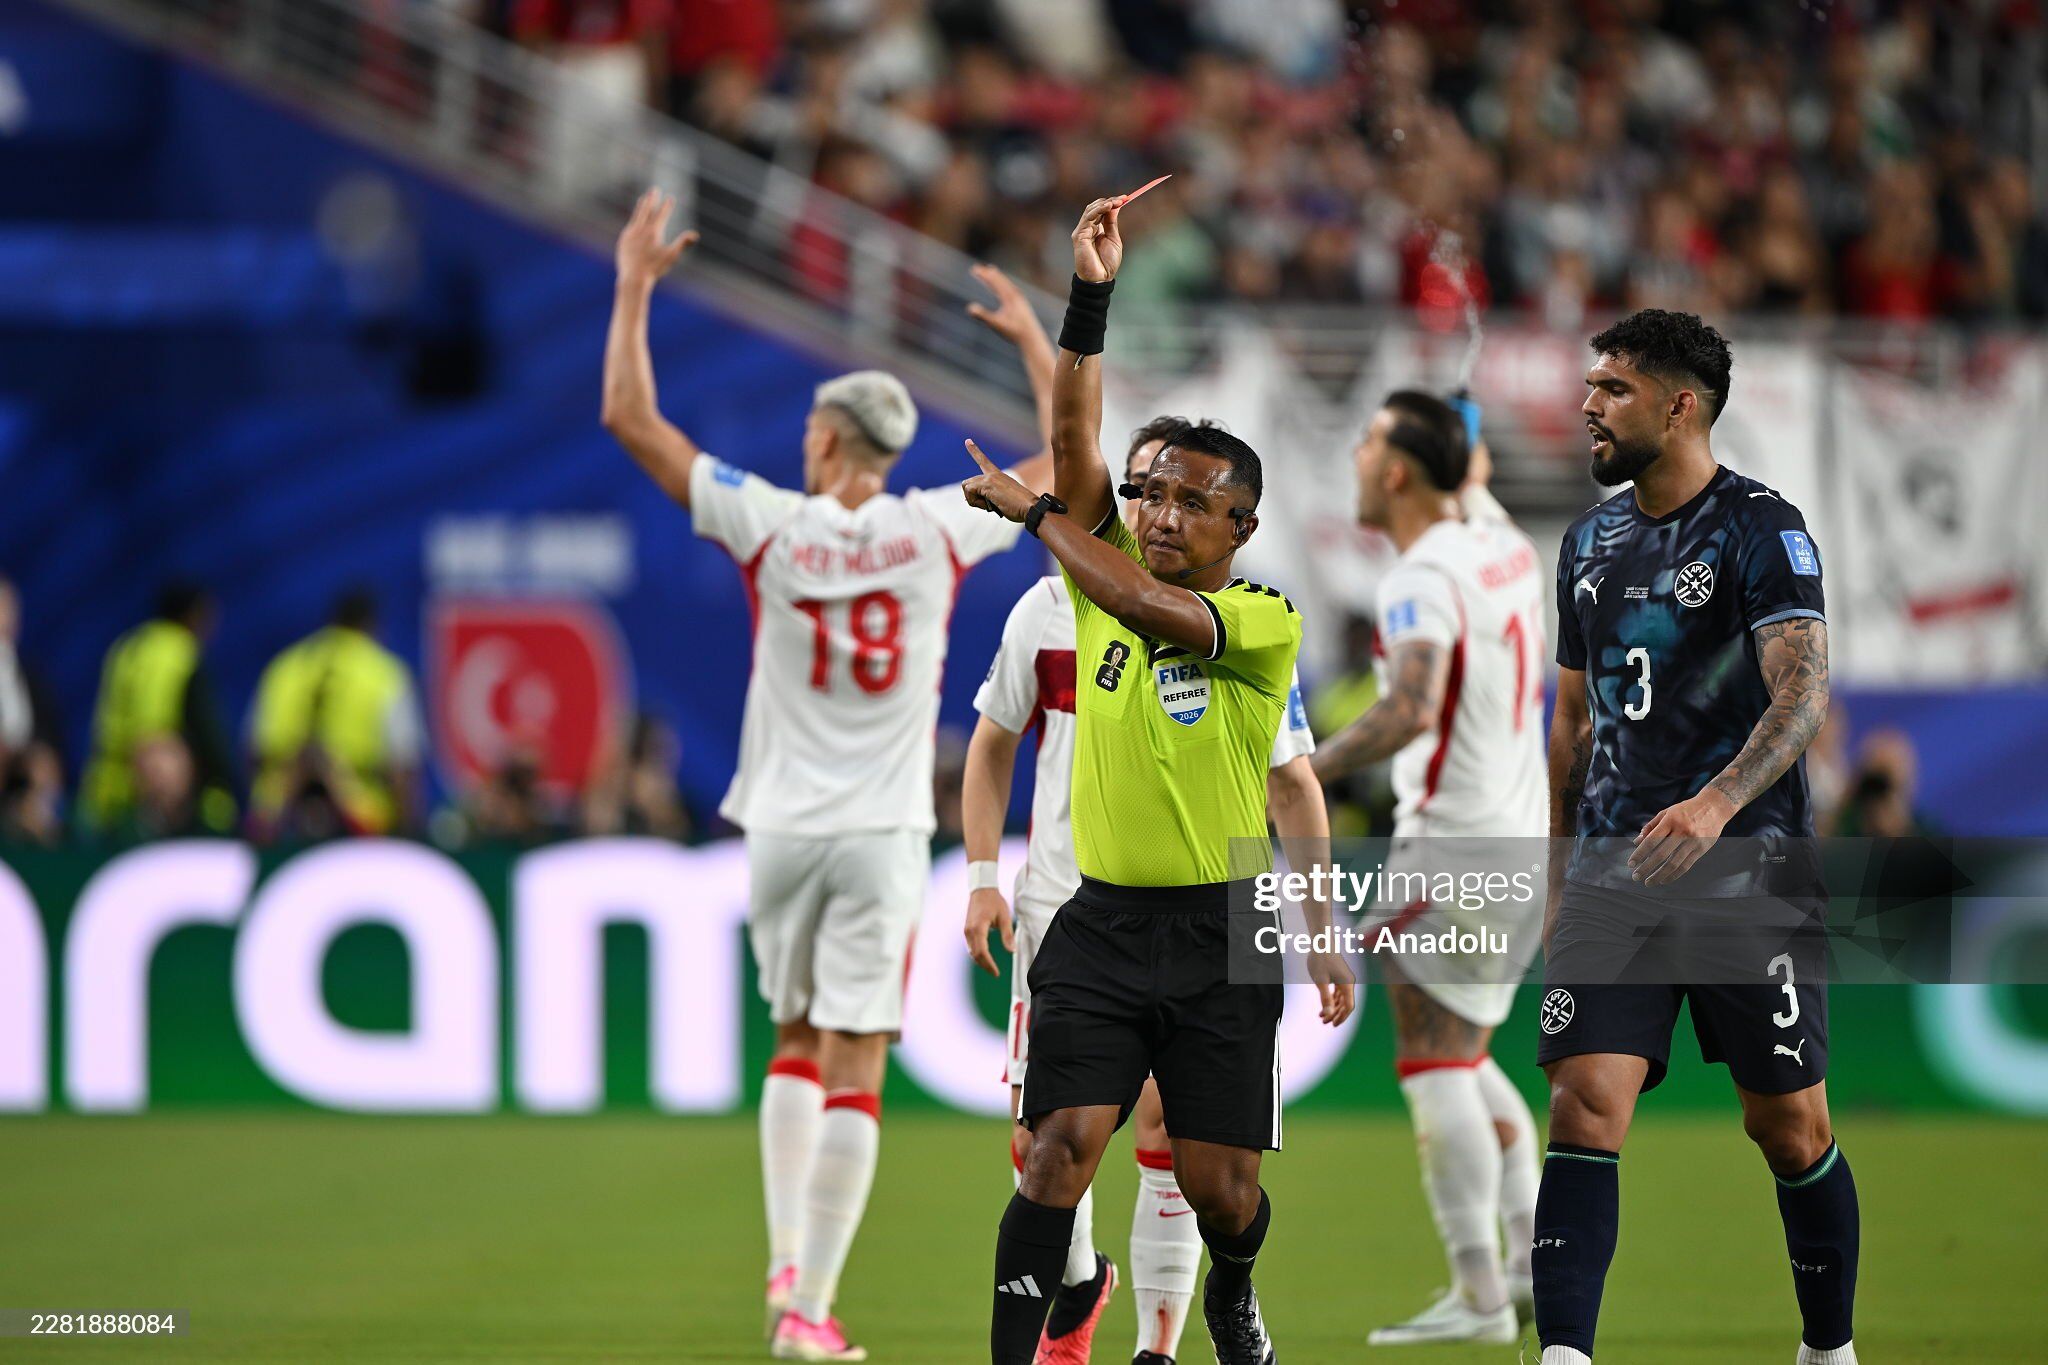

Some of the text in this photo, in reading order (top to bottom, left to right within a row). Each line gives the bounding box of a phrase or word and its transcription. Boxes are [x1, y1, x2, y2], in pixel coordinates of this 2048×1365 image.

[1690, 565, 1704, 573] APF
[793, 590, 903, 696] 18
[1100, 677, 1113, 688] FIFA
[1159, 663, 1204, 685] FIFA
[1623, 647, 1652, 721] 3
[1162, 687, 1208, 704] REFEREE
[1178, 710, 1199, 721] 2026
[1766, 952, 1800, 1029] 3
